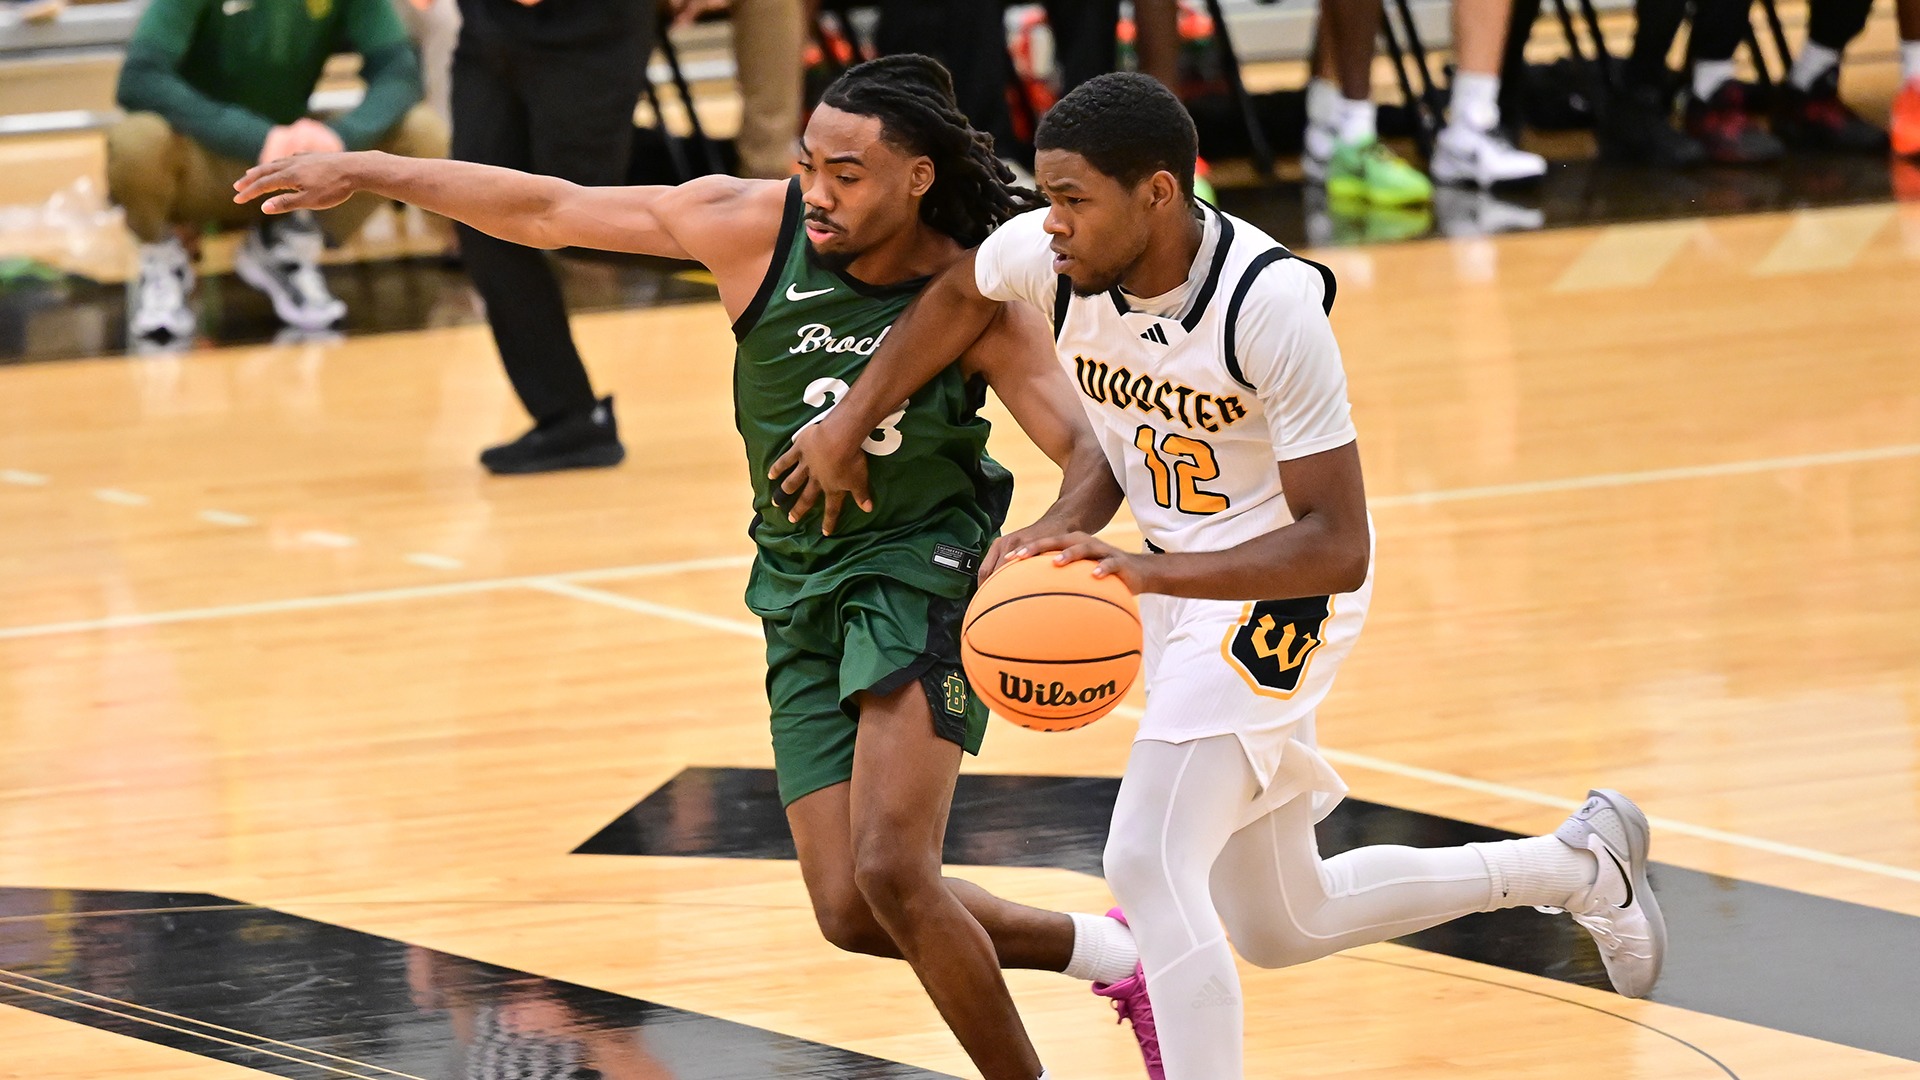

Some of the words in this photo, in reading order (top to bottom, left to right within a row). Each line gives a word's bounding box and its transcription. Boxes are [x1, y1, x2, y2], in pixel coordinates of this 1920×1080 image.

[1074, 353, 1248, 433] WOOSTER
[1134, 424, 1230, 515] 12
[966, 558, 972, 569] L
[1250, 613, 1318, 672] W
[943, 672, 967, 714] B
[998, 671, 1116, 706] Wilson
